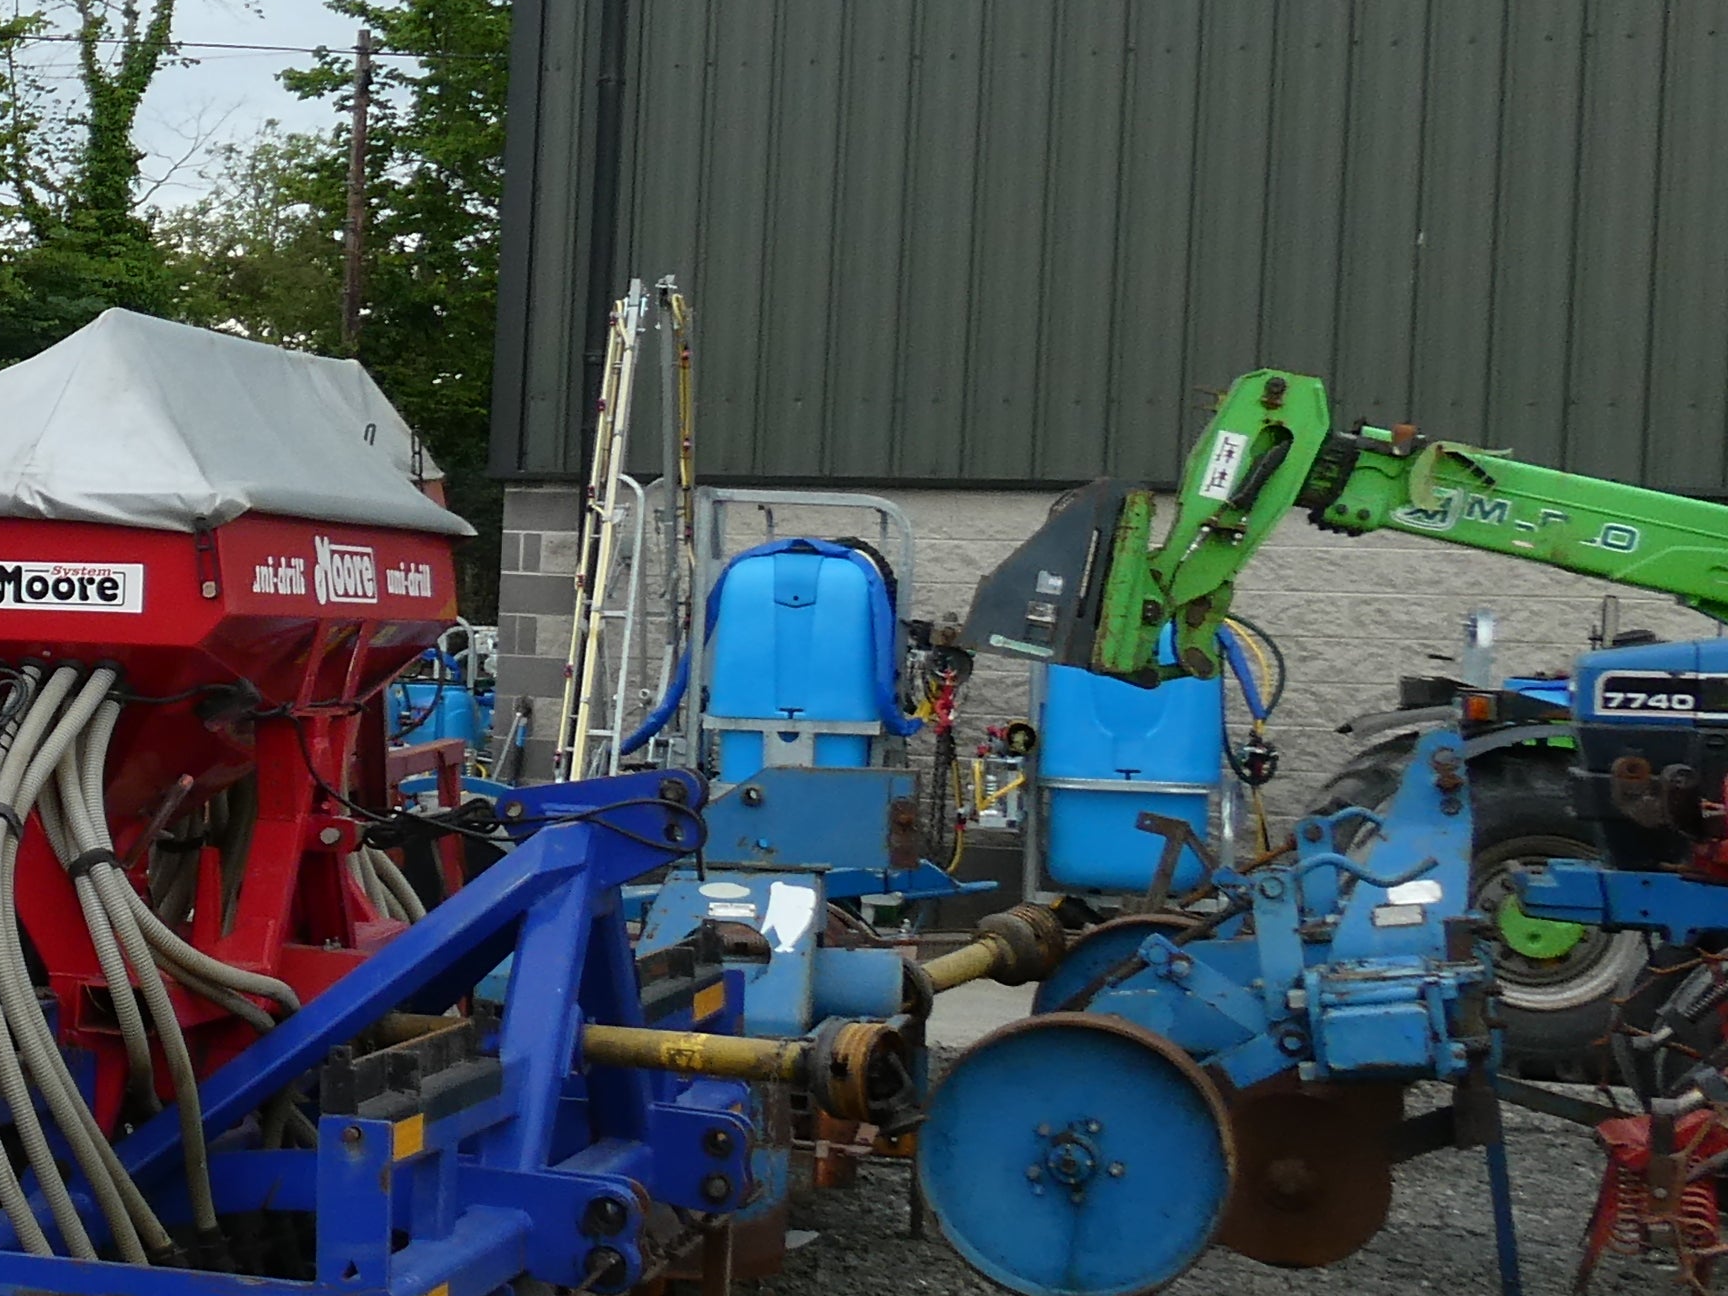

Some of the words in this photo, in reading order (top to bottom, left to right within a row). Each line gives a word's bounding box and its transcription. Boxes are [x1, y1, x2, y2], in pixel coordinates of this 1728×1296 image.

[50, 565, 112, 579] System
[314, 535, 375, 605] Moore
[1602, 691, 1696, 711] 7740
